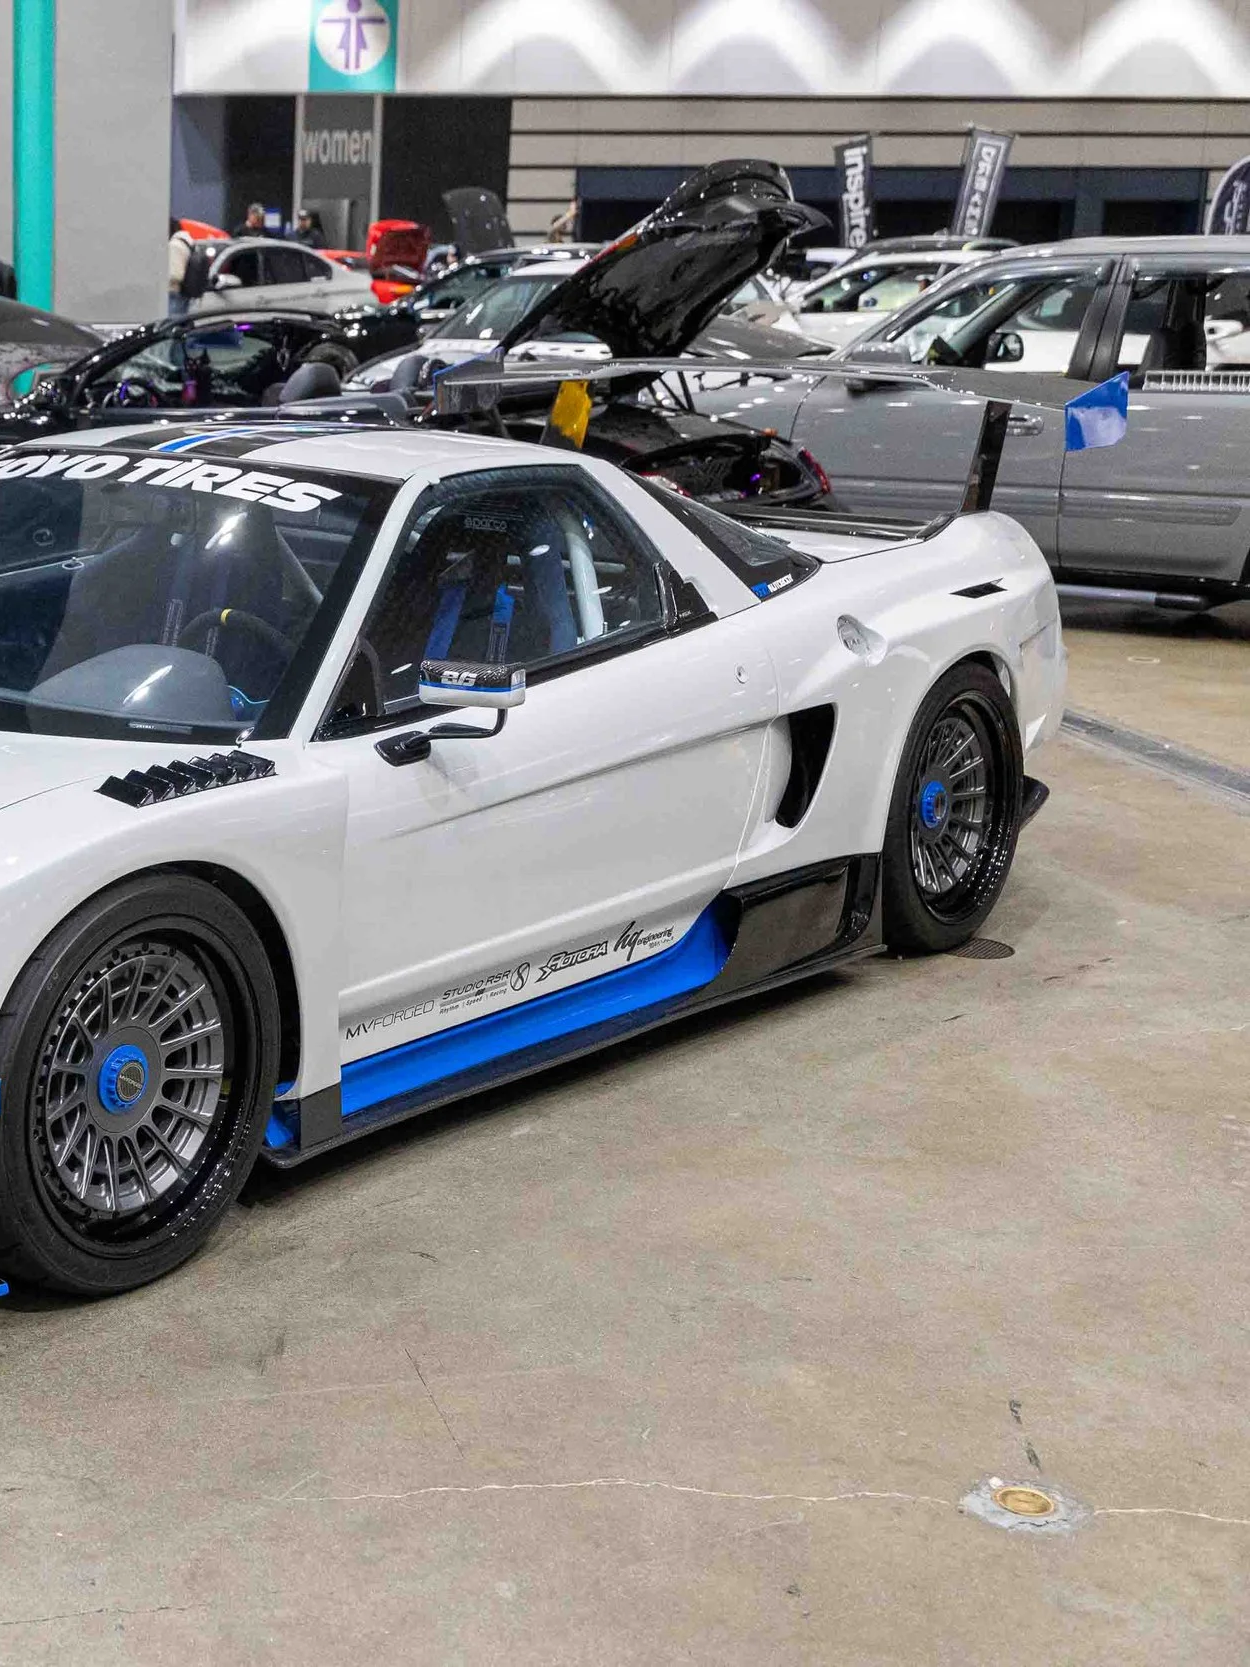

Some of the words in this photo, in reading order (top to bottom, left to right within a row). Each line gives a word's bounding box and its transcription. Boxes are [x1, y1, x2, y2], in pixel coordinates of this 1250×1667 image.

[302, 130, 372, 165] women
[843, 146, 871, 249] inspire
[117, 457, 343, 513] TIRES
[442, 979, 484, 1000] STUDIO
[484, 969, 511, 986] RSR
[465, 995, 483, 1006] Speed
[490, 987, 508, 998] Racing
[346, 999, 435, 1040] MVFORGED
